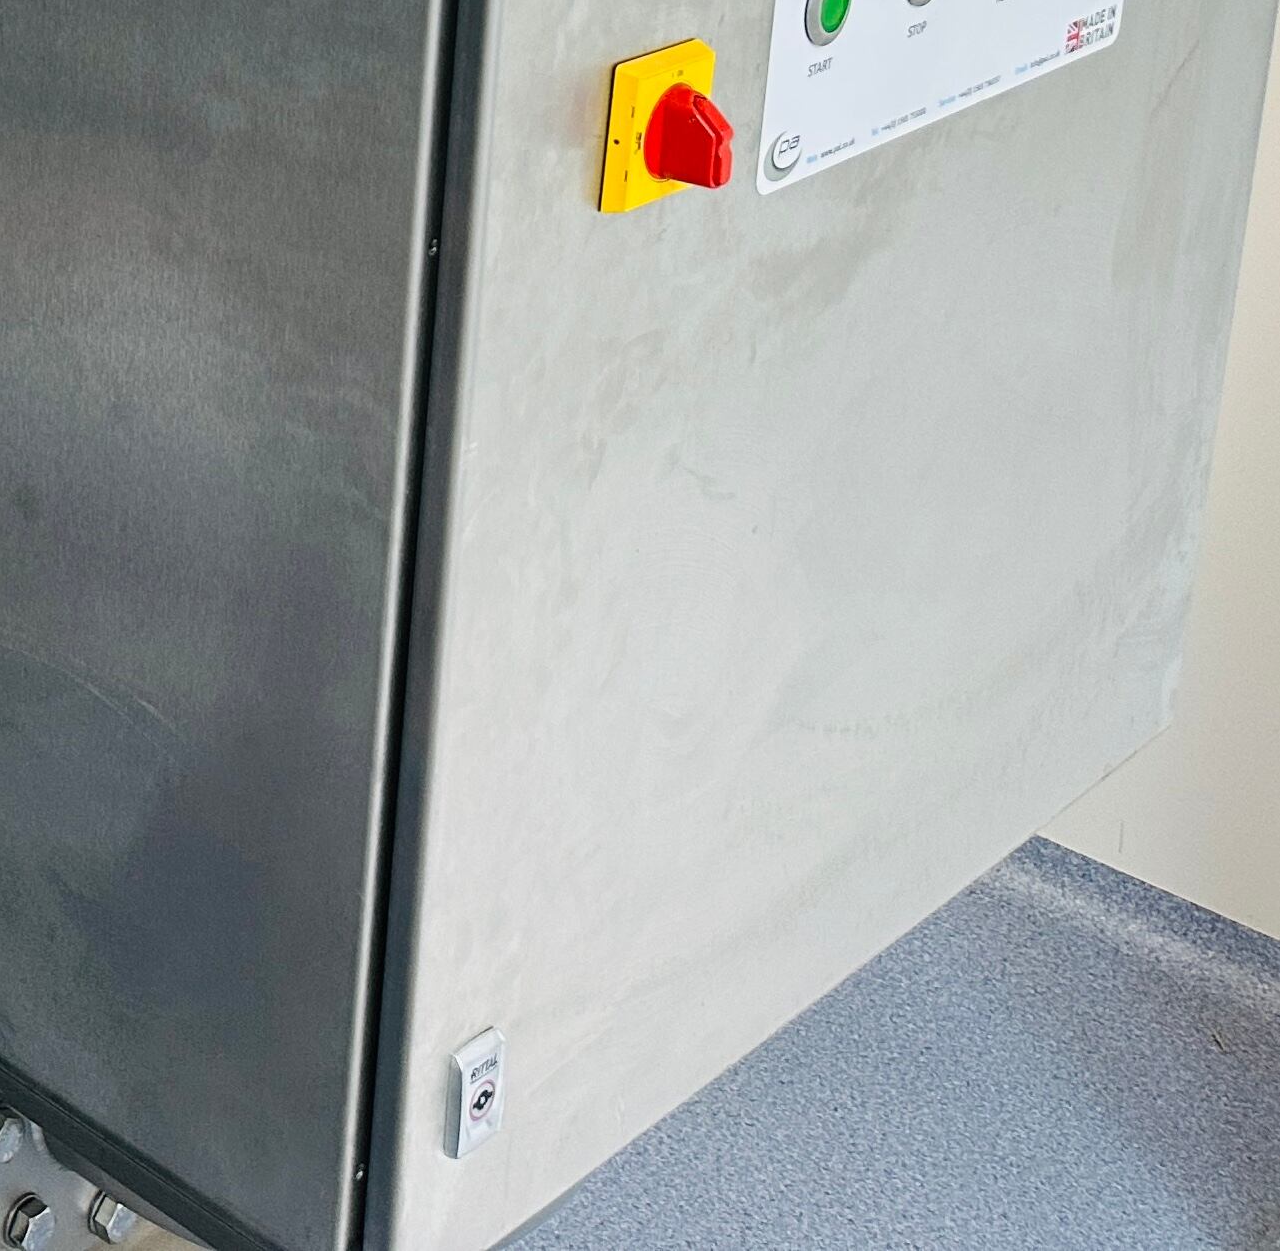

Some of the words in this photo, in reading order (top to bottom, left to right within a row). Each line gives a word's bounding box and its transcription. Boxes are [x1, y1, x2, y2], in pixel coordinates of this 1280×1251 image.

[907, 20, 927, 38] STOP
[1079, 8, 1106, 30] MADE
[1107, 4, 1117, 20] IN
[1078, 21, 1115, 47] BRITAIN
[807, 57, 833, 78] START
[470, 1052, 498, 1080] RITTAL
